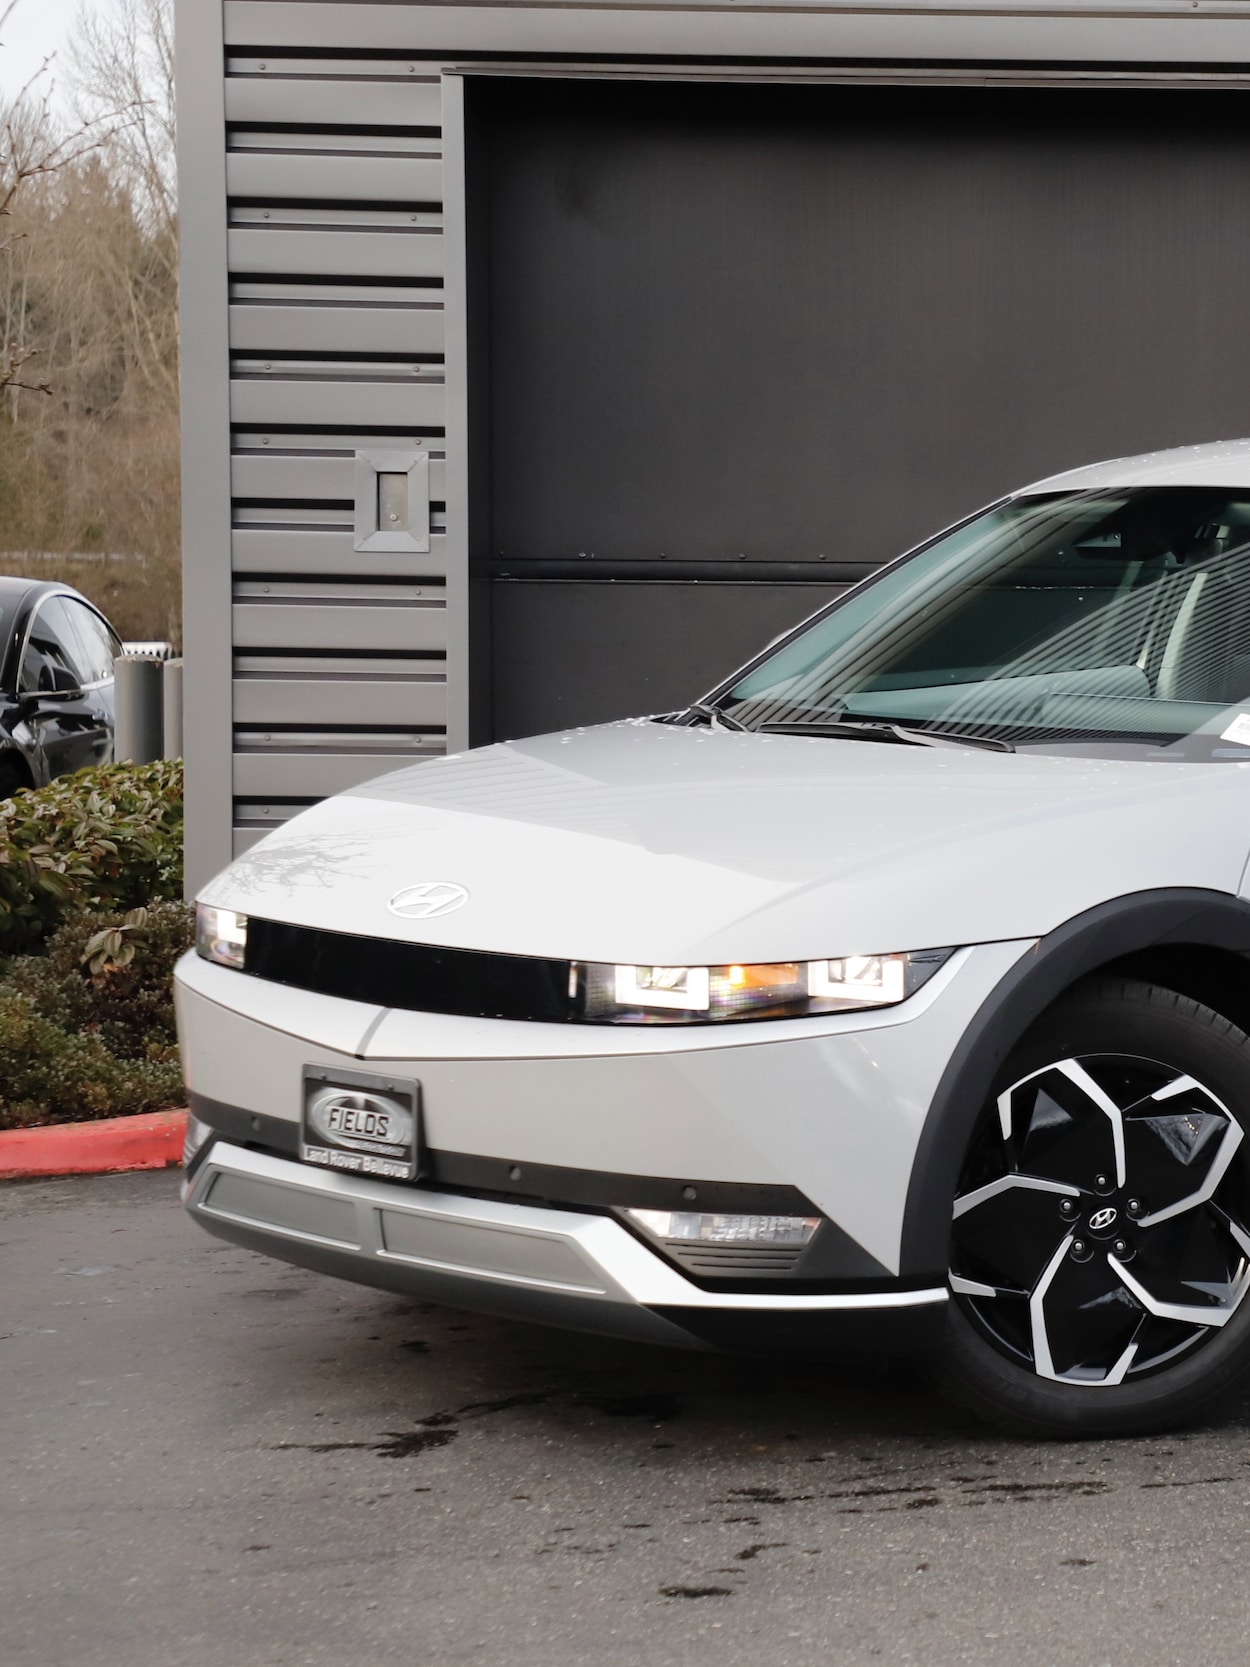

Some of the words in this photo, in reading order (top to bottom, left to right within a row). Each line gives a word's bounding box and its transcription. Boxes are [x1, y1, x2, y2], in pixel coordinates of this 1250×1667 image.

[328, 1107, 390, 1137] FIELDS
[304, 1146, 328, 1165] Land
[329, 1150, 361, 1170] Rover
[362, 1156, 410, 1179] Bellevue
